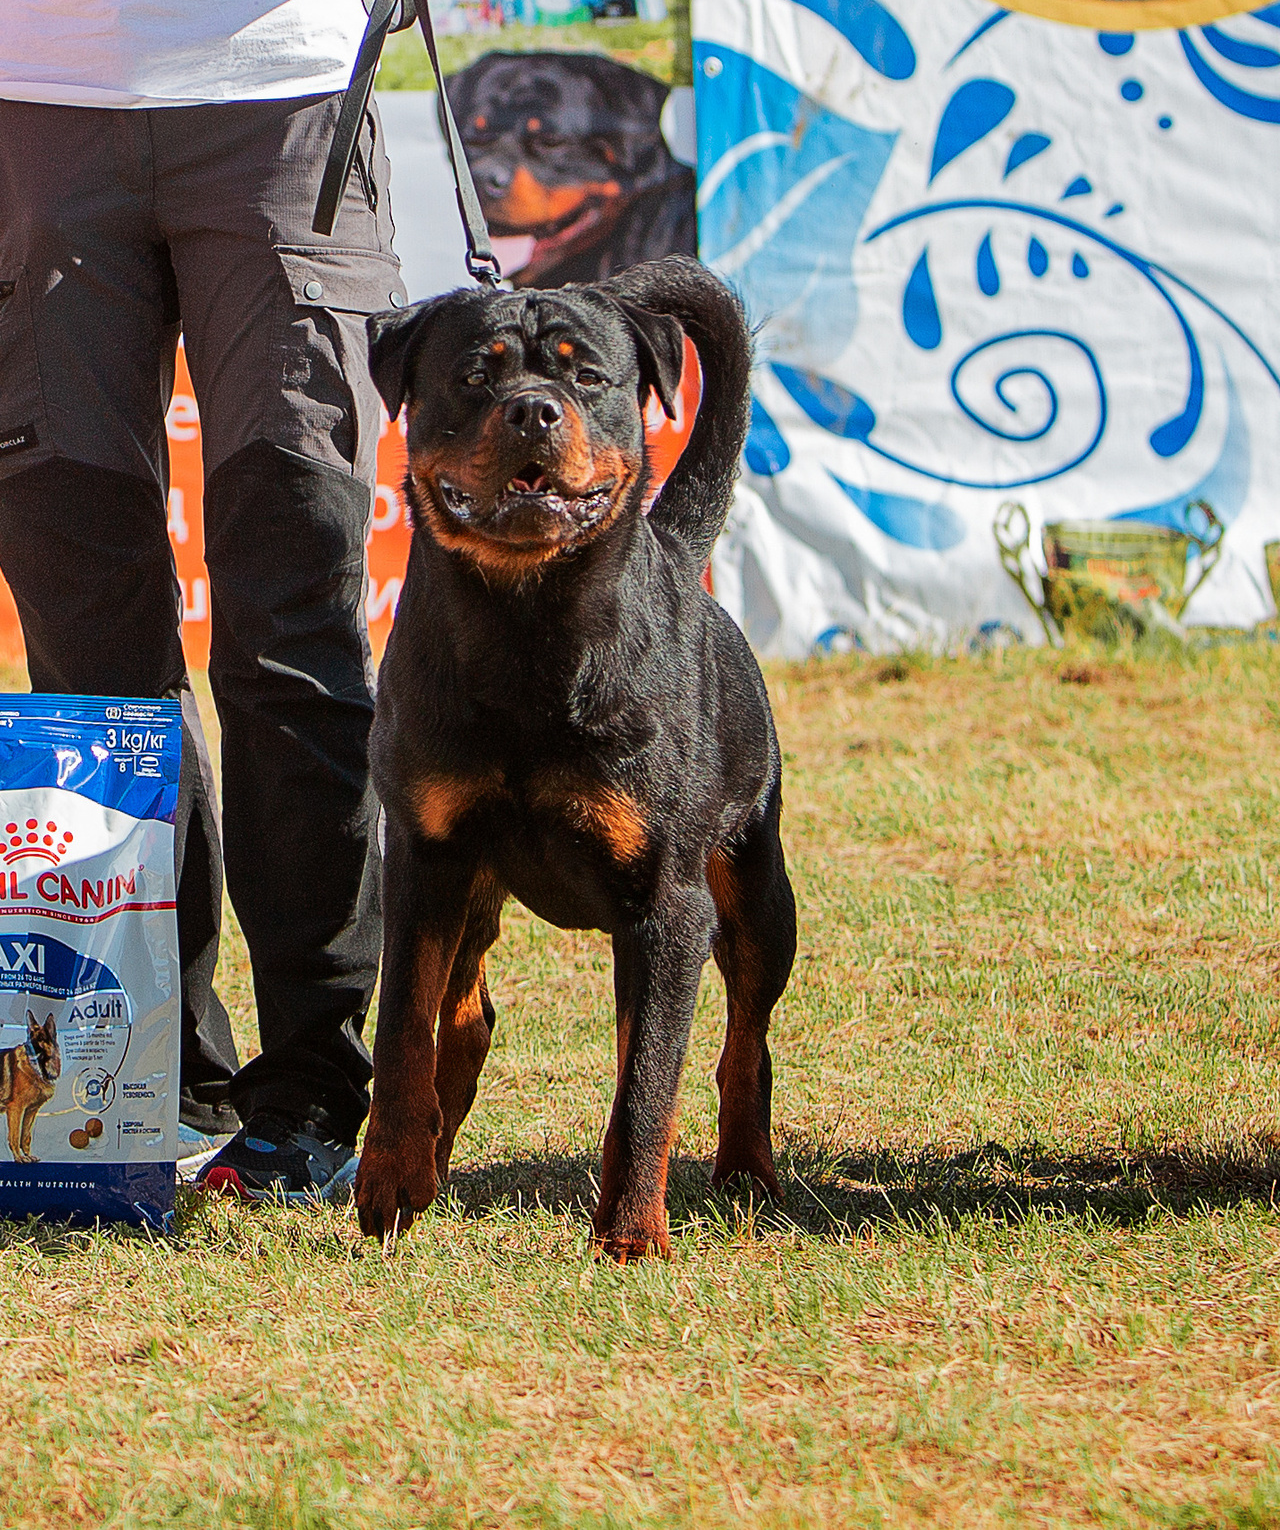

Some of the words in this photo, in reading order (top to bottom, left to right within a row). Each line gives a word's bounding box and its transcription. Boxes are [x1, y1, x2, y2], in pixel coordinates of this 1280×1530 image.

[106, 728, 117, 748] 3
[36, 868, 136, 909] CANIN
[1, 908, 47, 916] NUTRITION
[50, 911, 71, 921] SINCE
[68, 999, 122, 1023] Adult
[37, 1181, 96, 1189] NUTRITION
